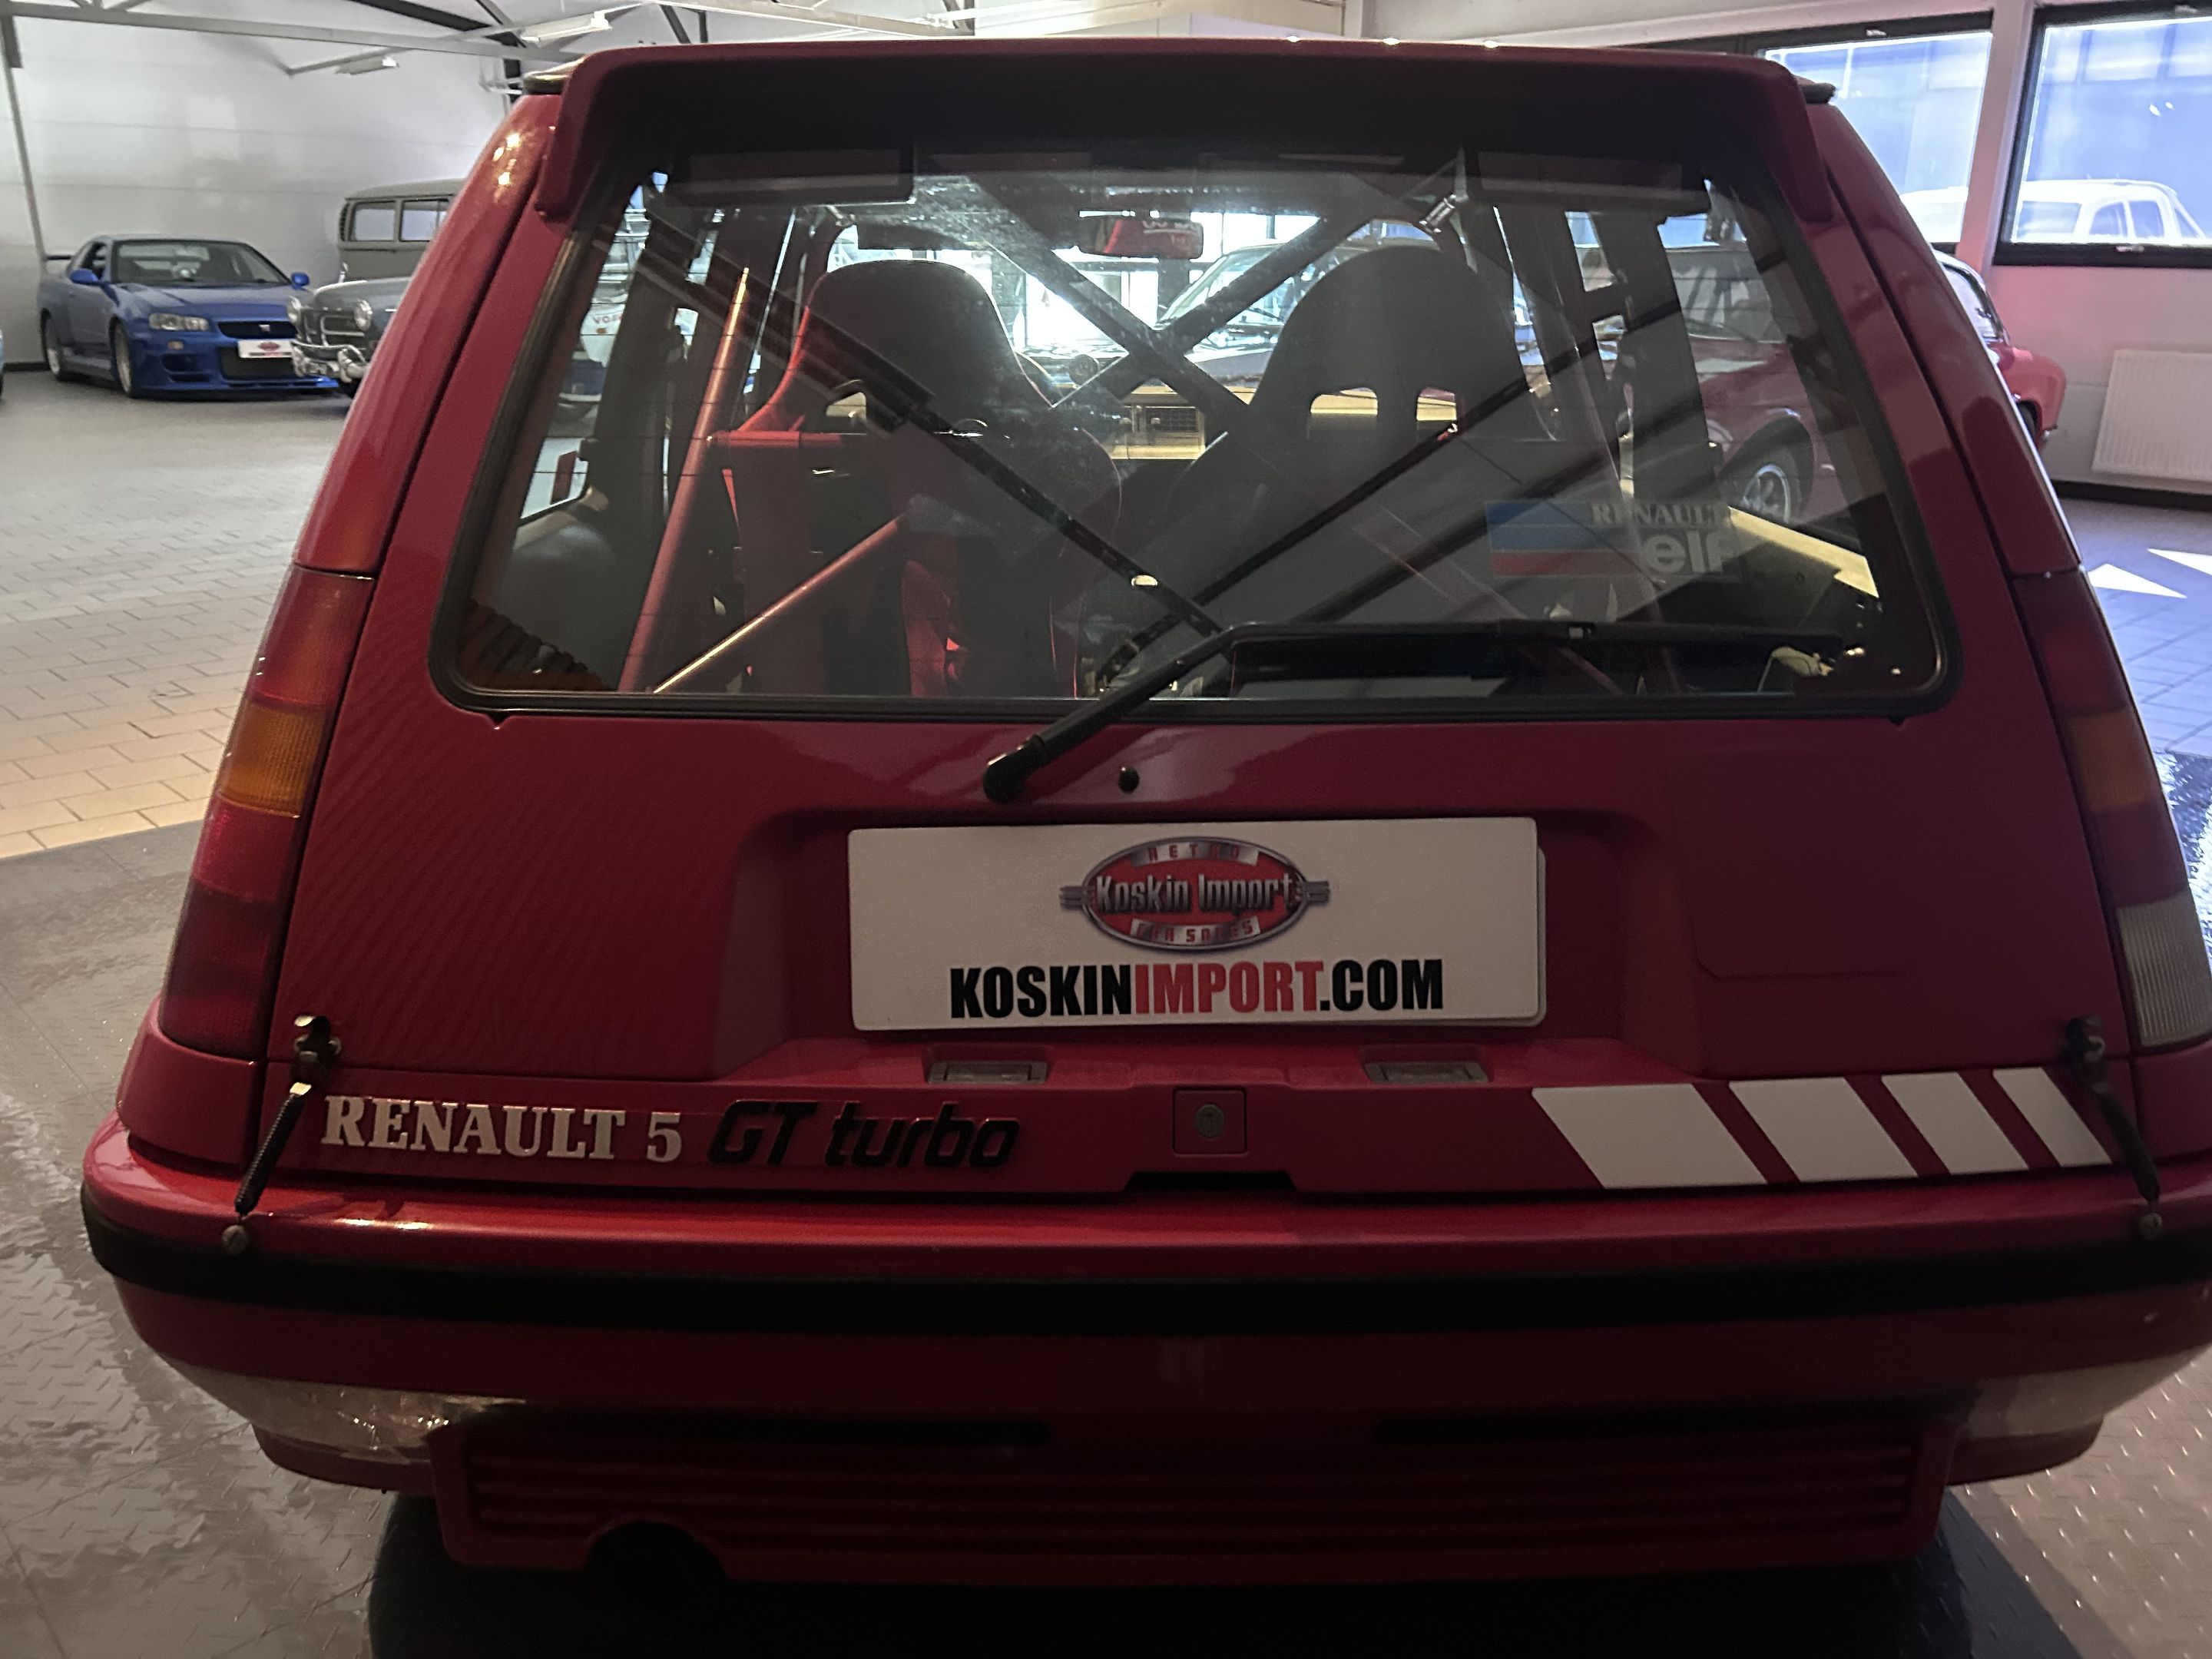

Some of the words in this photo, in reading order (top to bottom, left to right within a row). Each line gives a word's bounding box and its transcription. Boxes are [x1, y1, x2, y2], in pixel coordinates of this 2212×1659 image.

[1644, 531, 1734, 574] elf
[1095, 874, 1190, 914] Koskin
[1197, 873, 1294, 915] Import
[949, 959, 1444, 1018] KOSKINIMPORT.COM
[320, 1095, 626, 1160] RENAULT
[646, 1111, 682, 1163] 5
[707, 1099, 820, 1165] GT
[824, 1100, 1021, 1167] turbo
